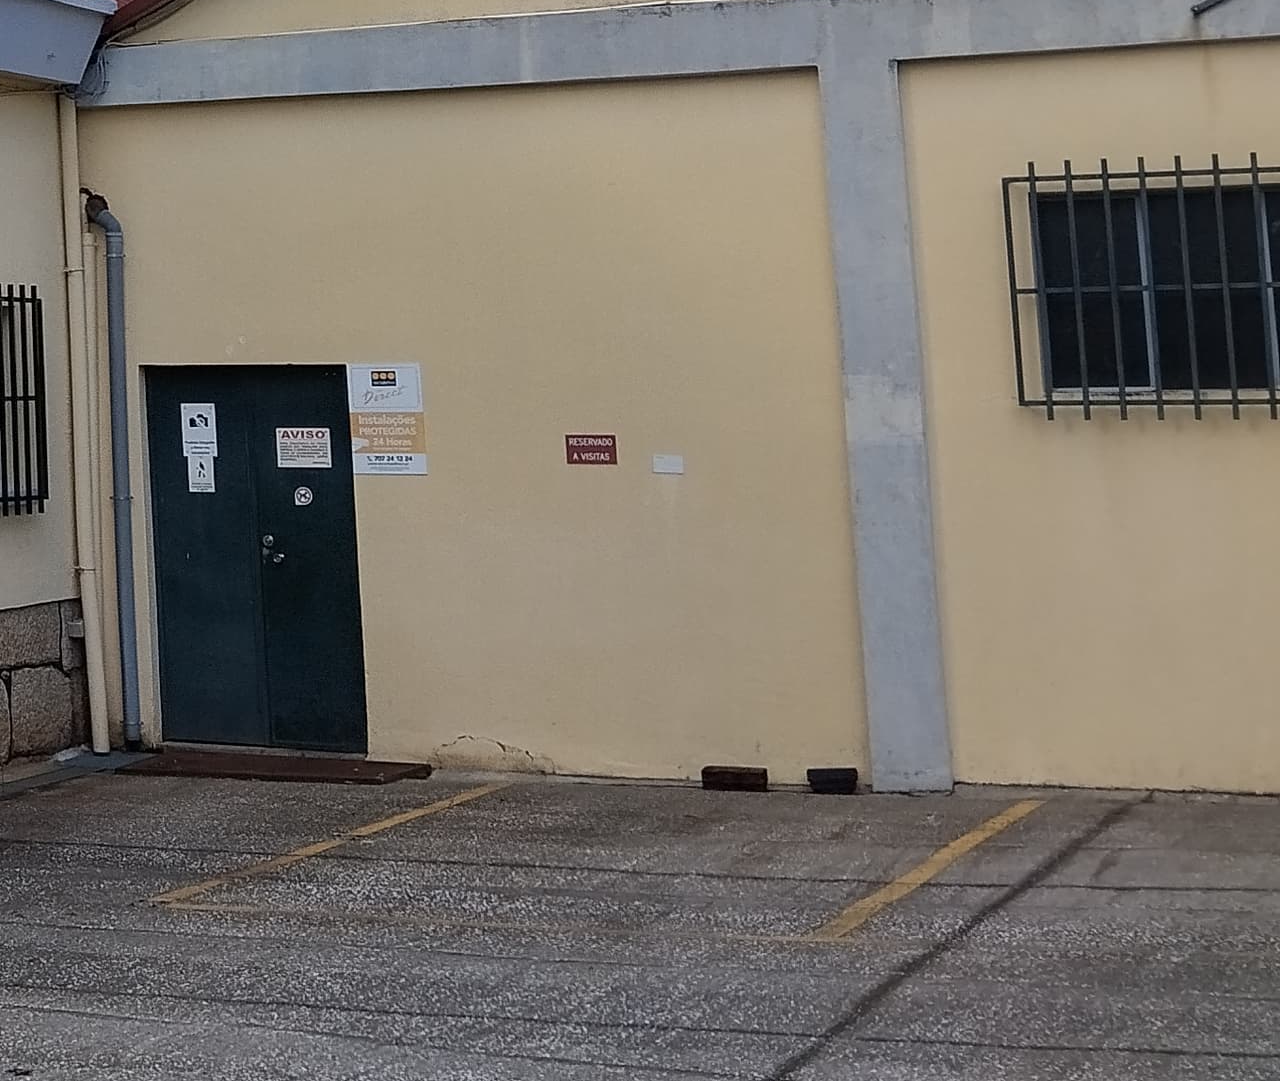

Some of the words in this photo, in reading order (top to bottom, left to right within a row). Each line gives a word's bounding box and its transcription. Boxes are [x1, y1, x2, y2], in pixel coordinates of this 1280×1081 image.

[358, 414, 416, 426] Instalações
[281, 430, 325, 439] AVISO
[359, 426, 417, 435] PROTEGIDAS
[386, 437, 412, 446] Horas
[568, 437, 613, 446] RESERVADO
[572, 452, 579, 461] A
[580, 452, 610, 461] VISITAS
